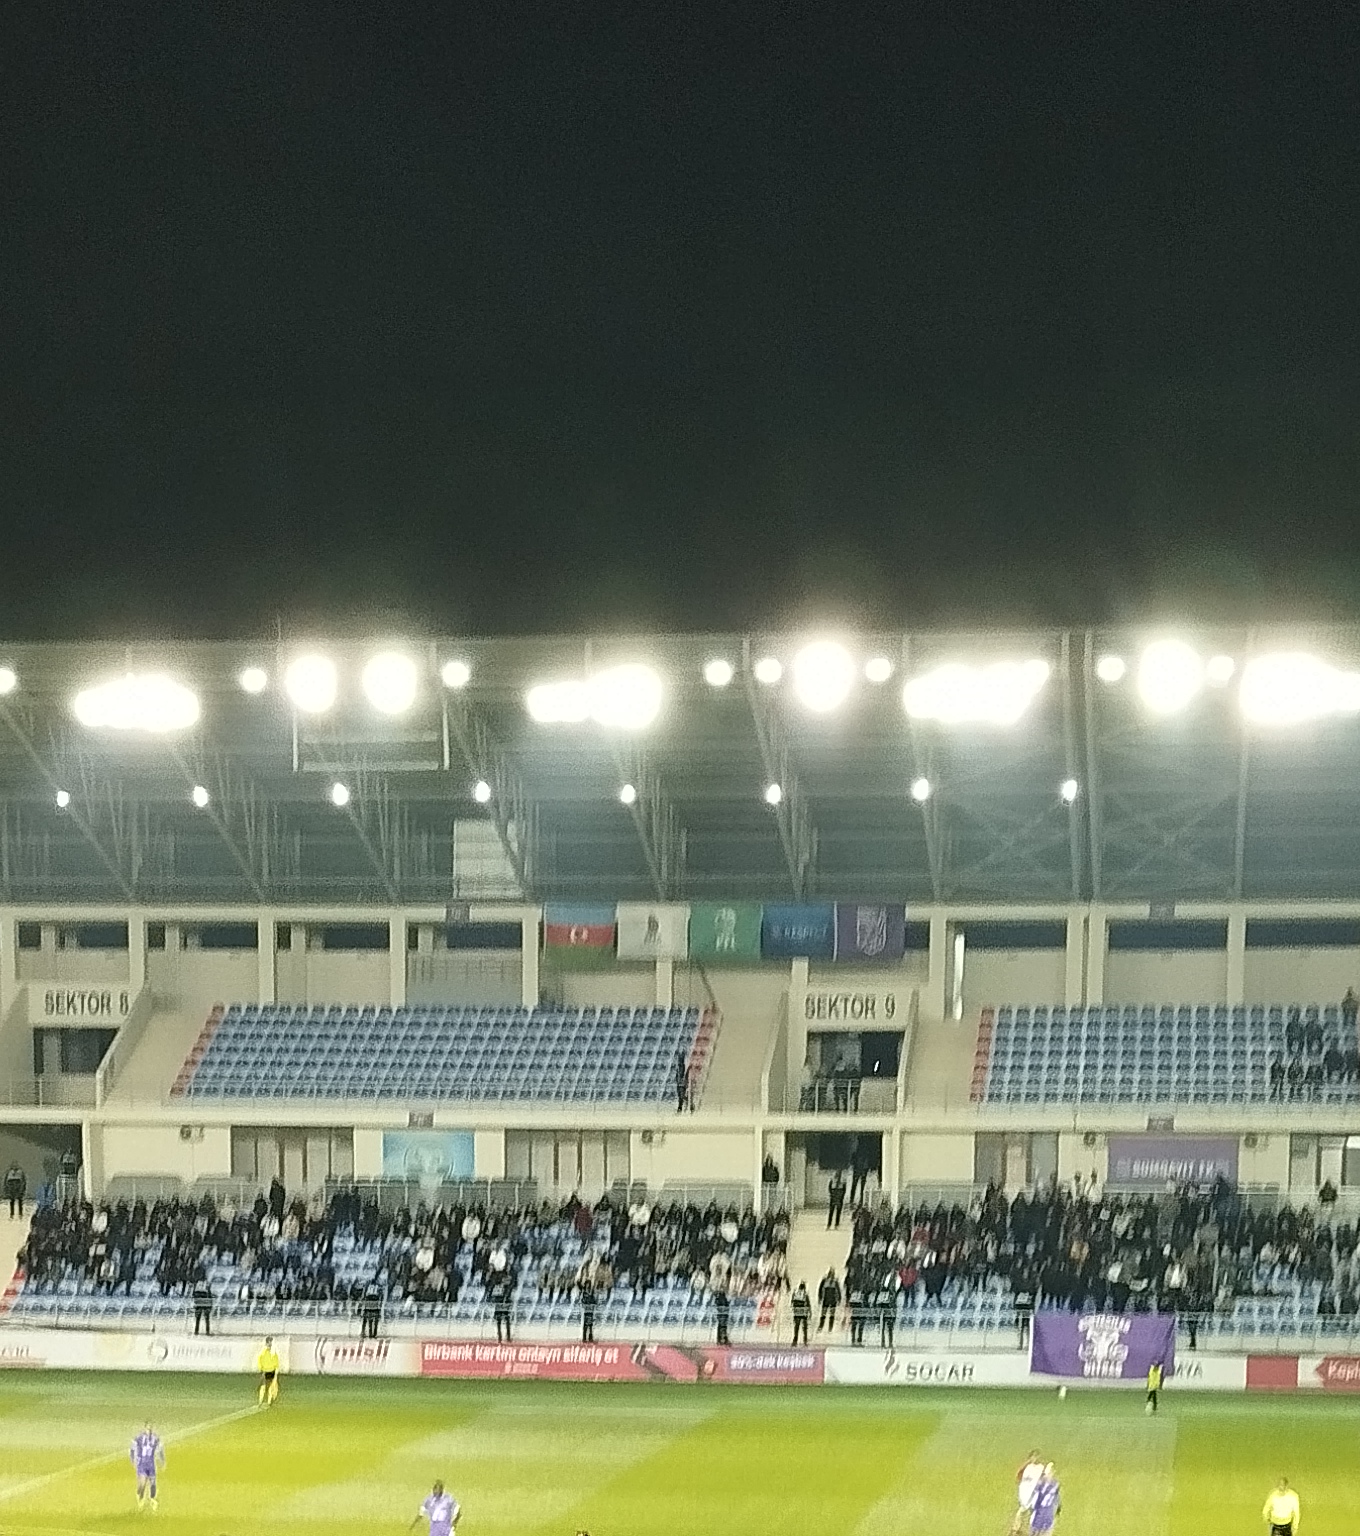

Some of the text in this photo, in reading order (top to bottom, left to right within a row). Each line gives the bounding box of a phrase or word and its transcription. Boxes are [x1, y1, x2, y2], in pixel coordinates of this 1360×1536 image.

[45, 989, 129, 1016] SEKTOR 8
[805, 992, 895, 1019] SEKTOR 9
[906, 1361, 975, 1382] SOCAR
